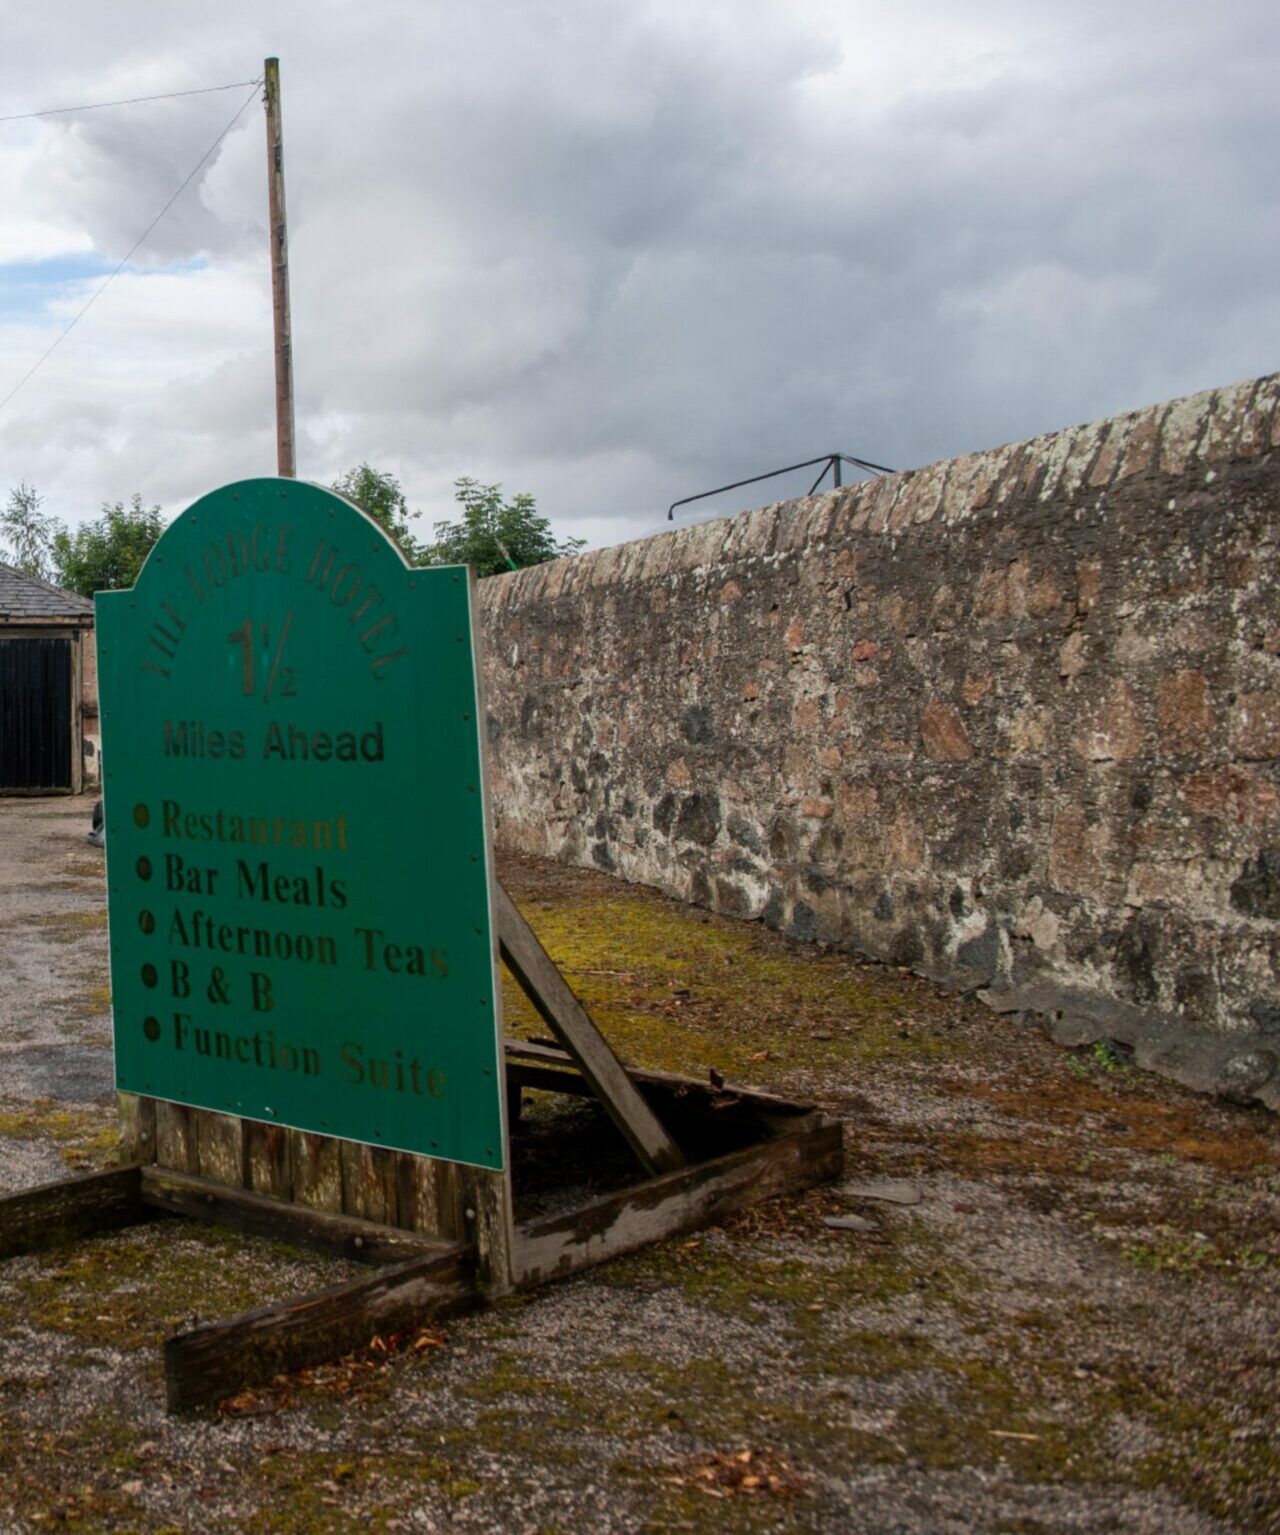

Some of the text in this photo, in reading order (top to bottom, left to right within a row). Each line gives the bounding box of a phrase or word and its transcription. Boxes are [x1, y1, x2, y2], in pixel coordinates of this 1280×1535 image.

[183, 523, 295, 604] LODGE
[305, 537, 410, 683] HOTEL
[163, 721, 384, 762] Miles Ahead
[161, 800, 348, 851] Restaurant
[164, 853, 347, 909] Bar Meals
[168, 908, 450, 979] Afternoon Teas
[170, 960, 275, 1013] B & B
[173, 1014, 448, 1099] Function Suite
